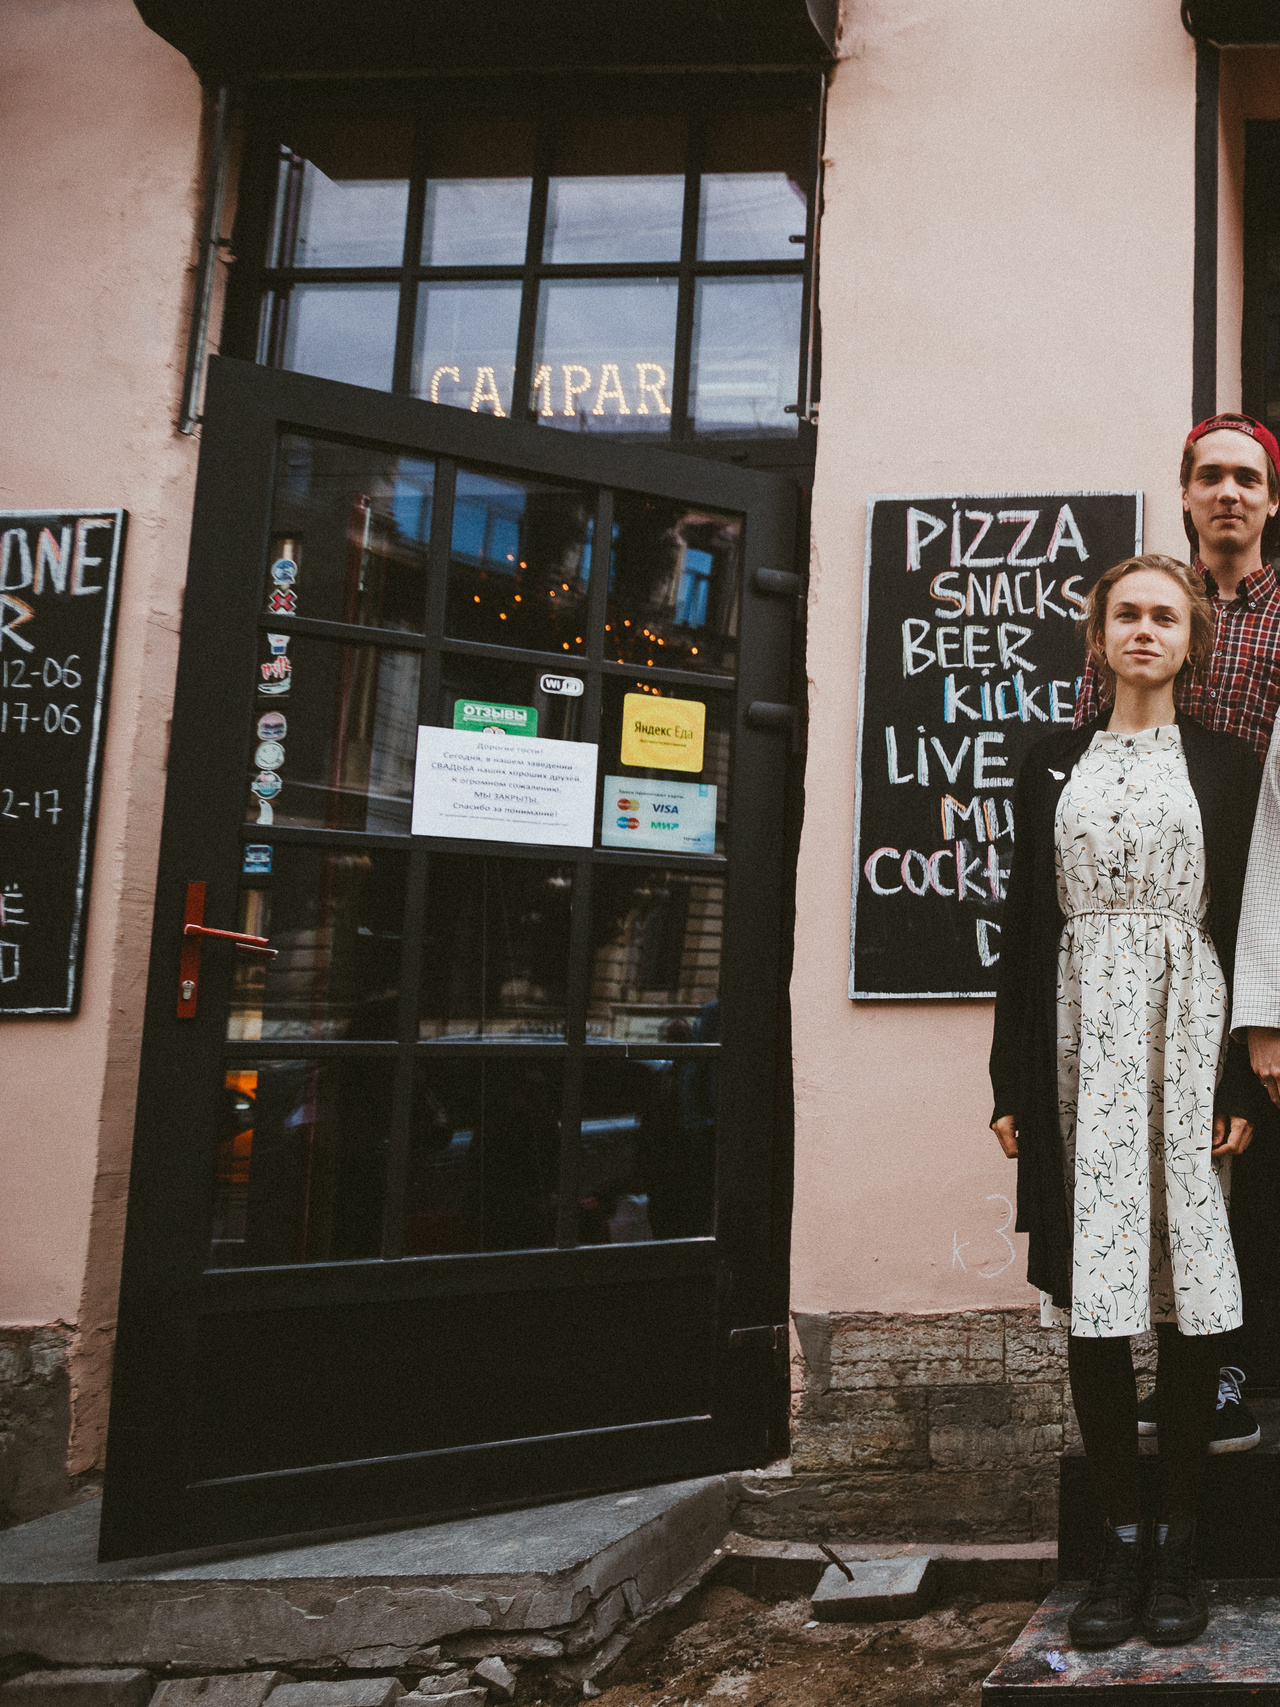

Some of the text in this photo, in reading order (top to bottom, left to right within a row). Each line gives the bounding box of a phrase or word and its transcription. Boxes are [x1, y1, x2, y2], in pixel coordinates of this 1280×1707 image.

[929, 568, 1091, 620] SNACKS
[902, 618, 1038, 679] BEER
[3, 654, 83, 689] 12-06
[1, 702, 82, 735] 17-06
[463, 704, 527, 722] ОТЗЫВЫ
[634, 720, 693, 740] Яндекс Еда
[431, 762, 475, 772] СВАДЬБА
[509, 771, 547, 779] хороших
[474, 791, 491, 799] МЫ
[453, 802, 491, 812] Спасибо
[652, 803, 679, 814] VISA
